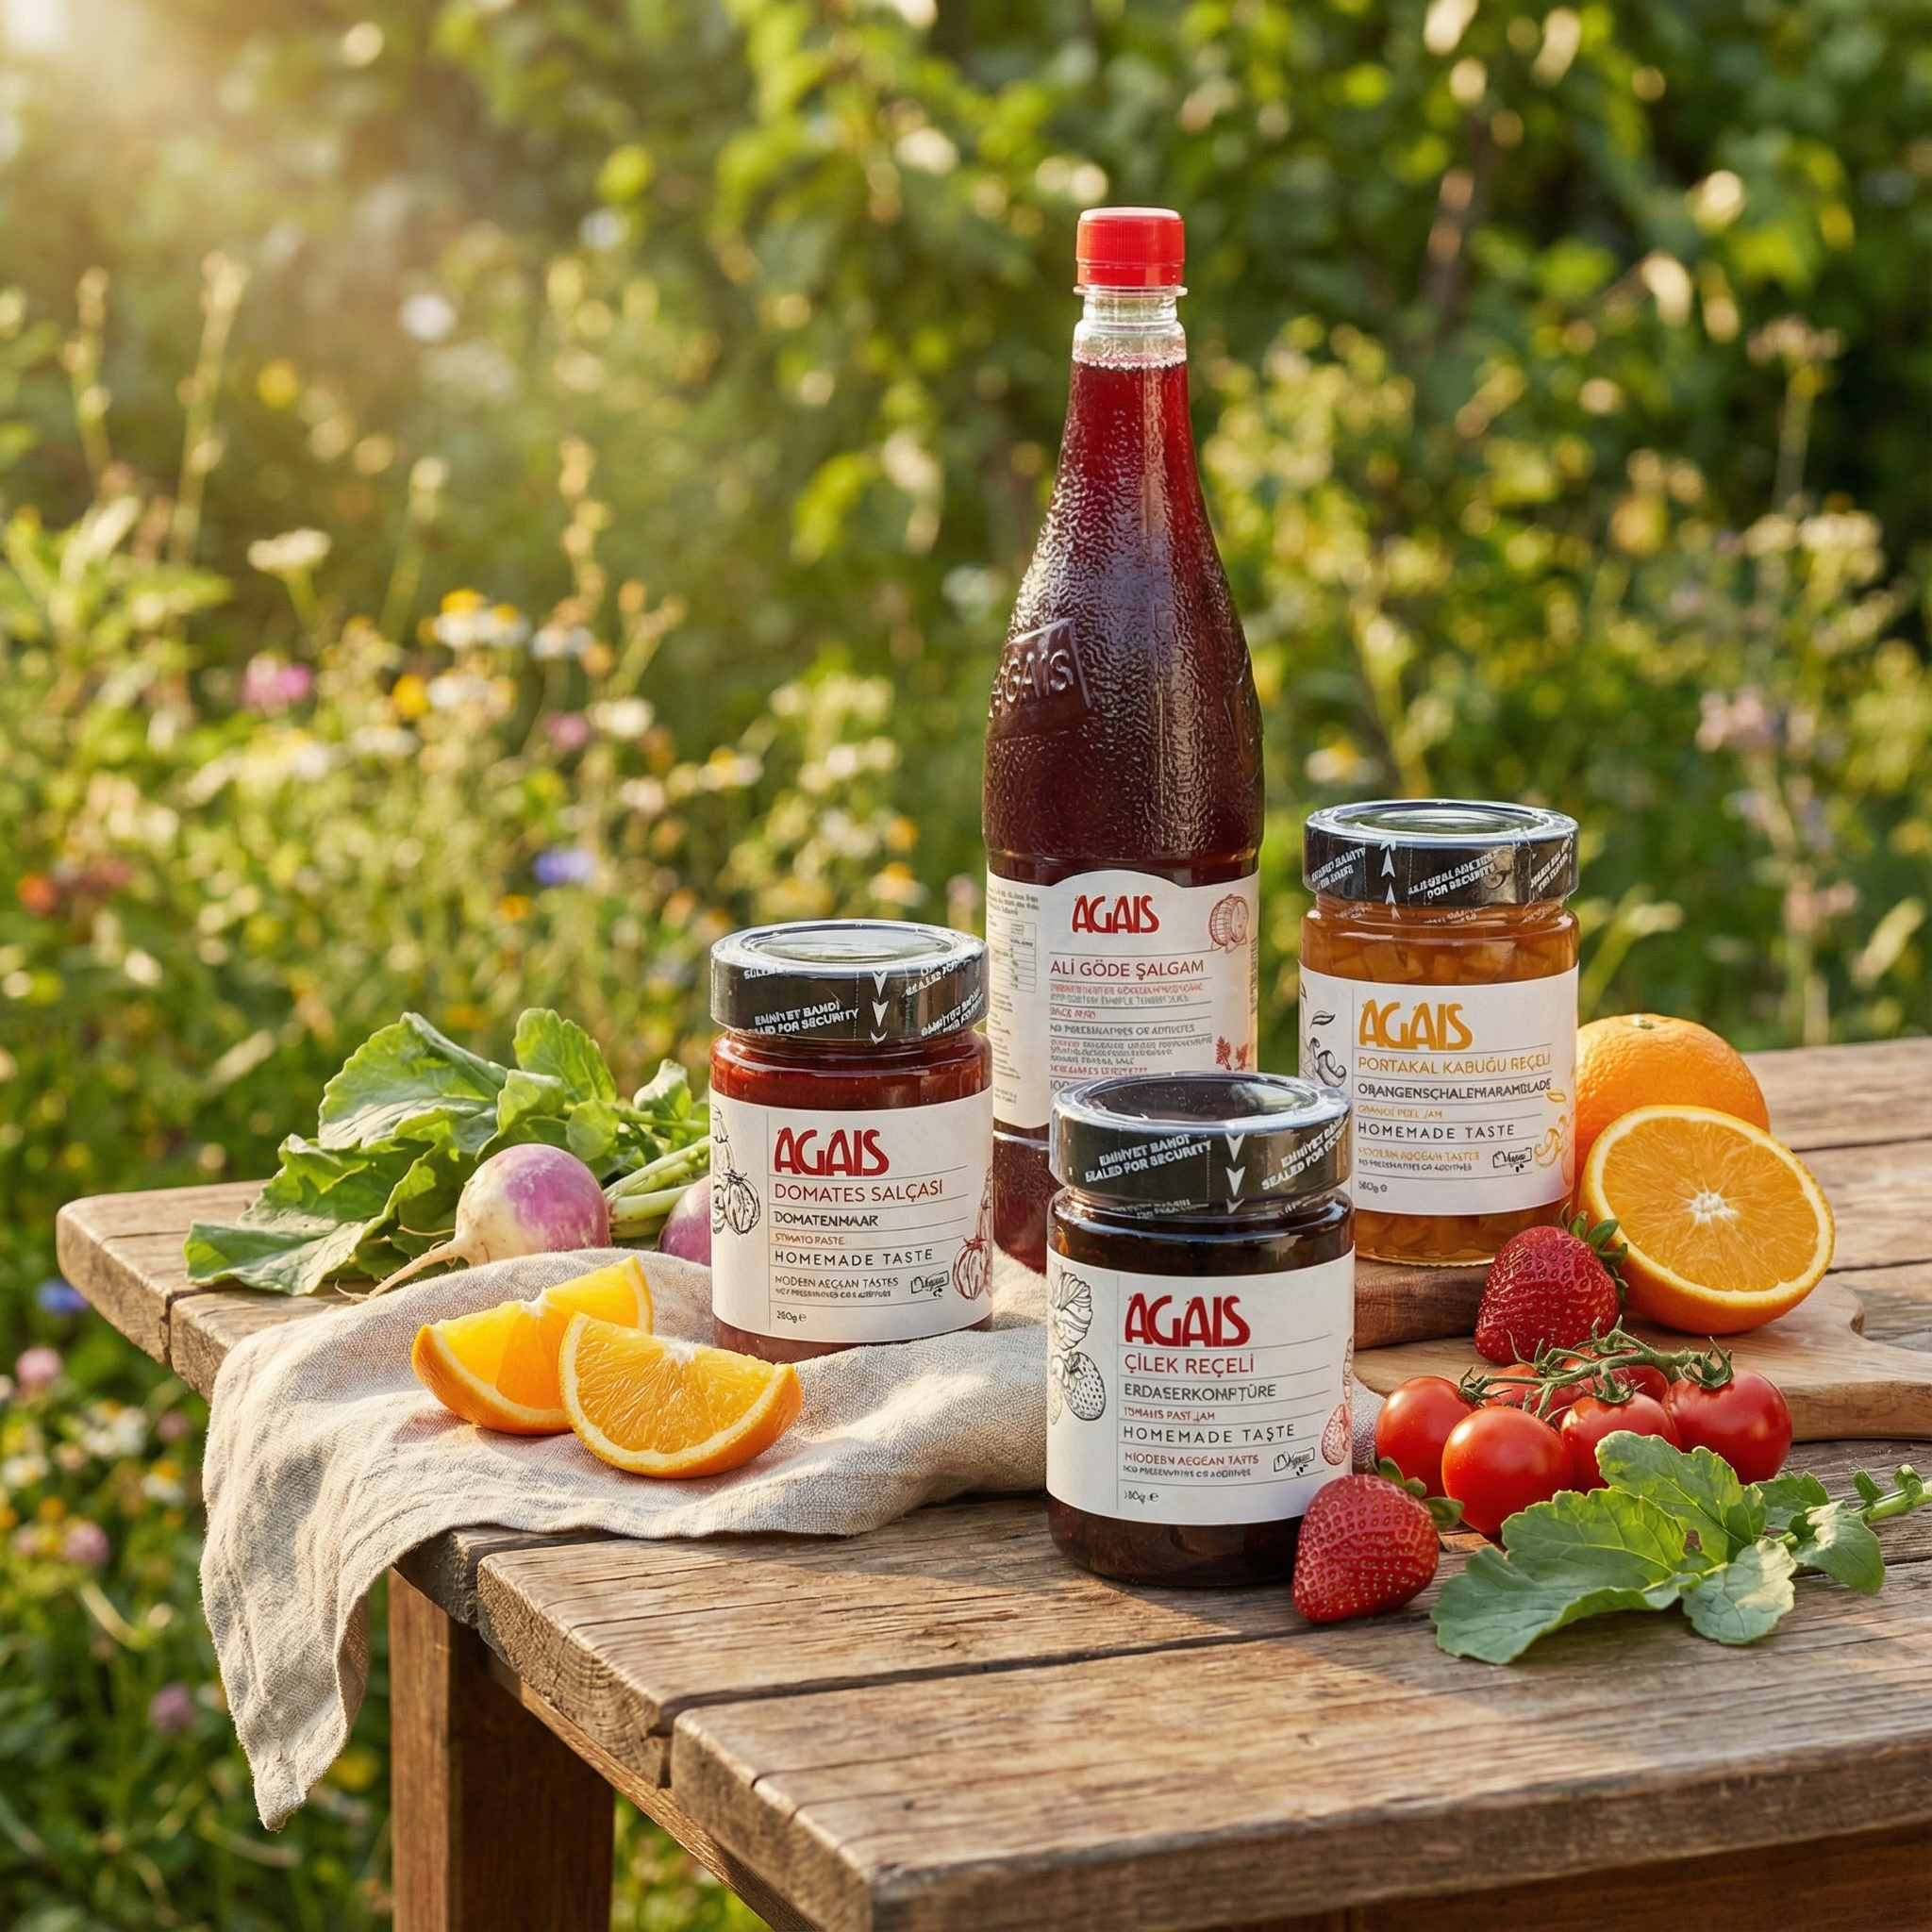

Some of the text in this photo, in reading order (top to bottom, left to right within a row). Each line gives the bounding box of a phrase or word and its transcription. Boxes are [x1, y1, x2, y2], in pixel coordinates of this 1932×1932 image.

[1080, 959, 1130, 977] GÖDE
[1136, 959, 1204, 981] ŞALGAM
[1359, 999, 1473, 1050] AGAIS
[1358, 1057, 1439, 1074] PORTAKAL
[1443, 1056, 1507, 1074] KABUĞU
[1357, 1122, 1456, 1140] HOMEMADE
[1465, 1124, 1515, 1139] TASTE
[774, 1126, 890, 1176] AGAIS
[774, 1179, 942, 1203] DOMATES SALÇASI
[774, 1248, 933, 1266] HOMEMADE TASTE
[1124, 1292, 1251, 1347] AGAIS
[1124, 1353, 1255, 1378] ÇİLEK REÇELİ
[1124, 1426, 1233, 1443] HOMEMADE
